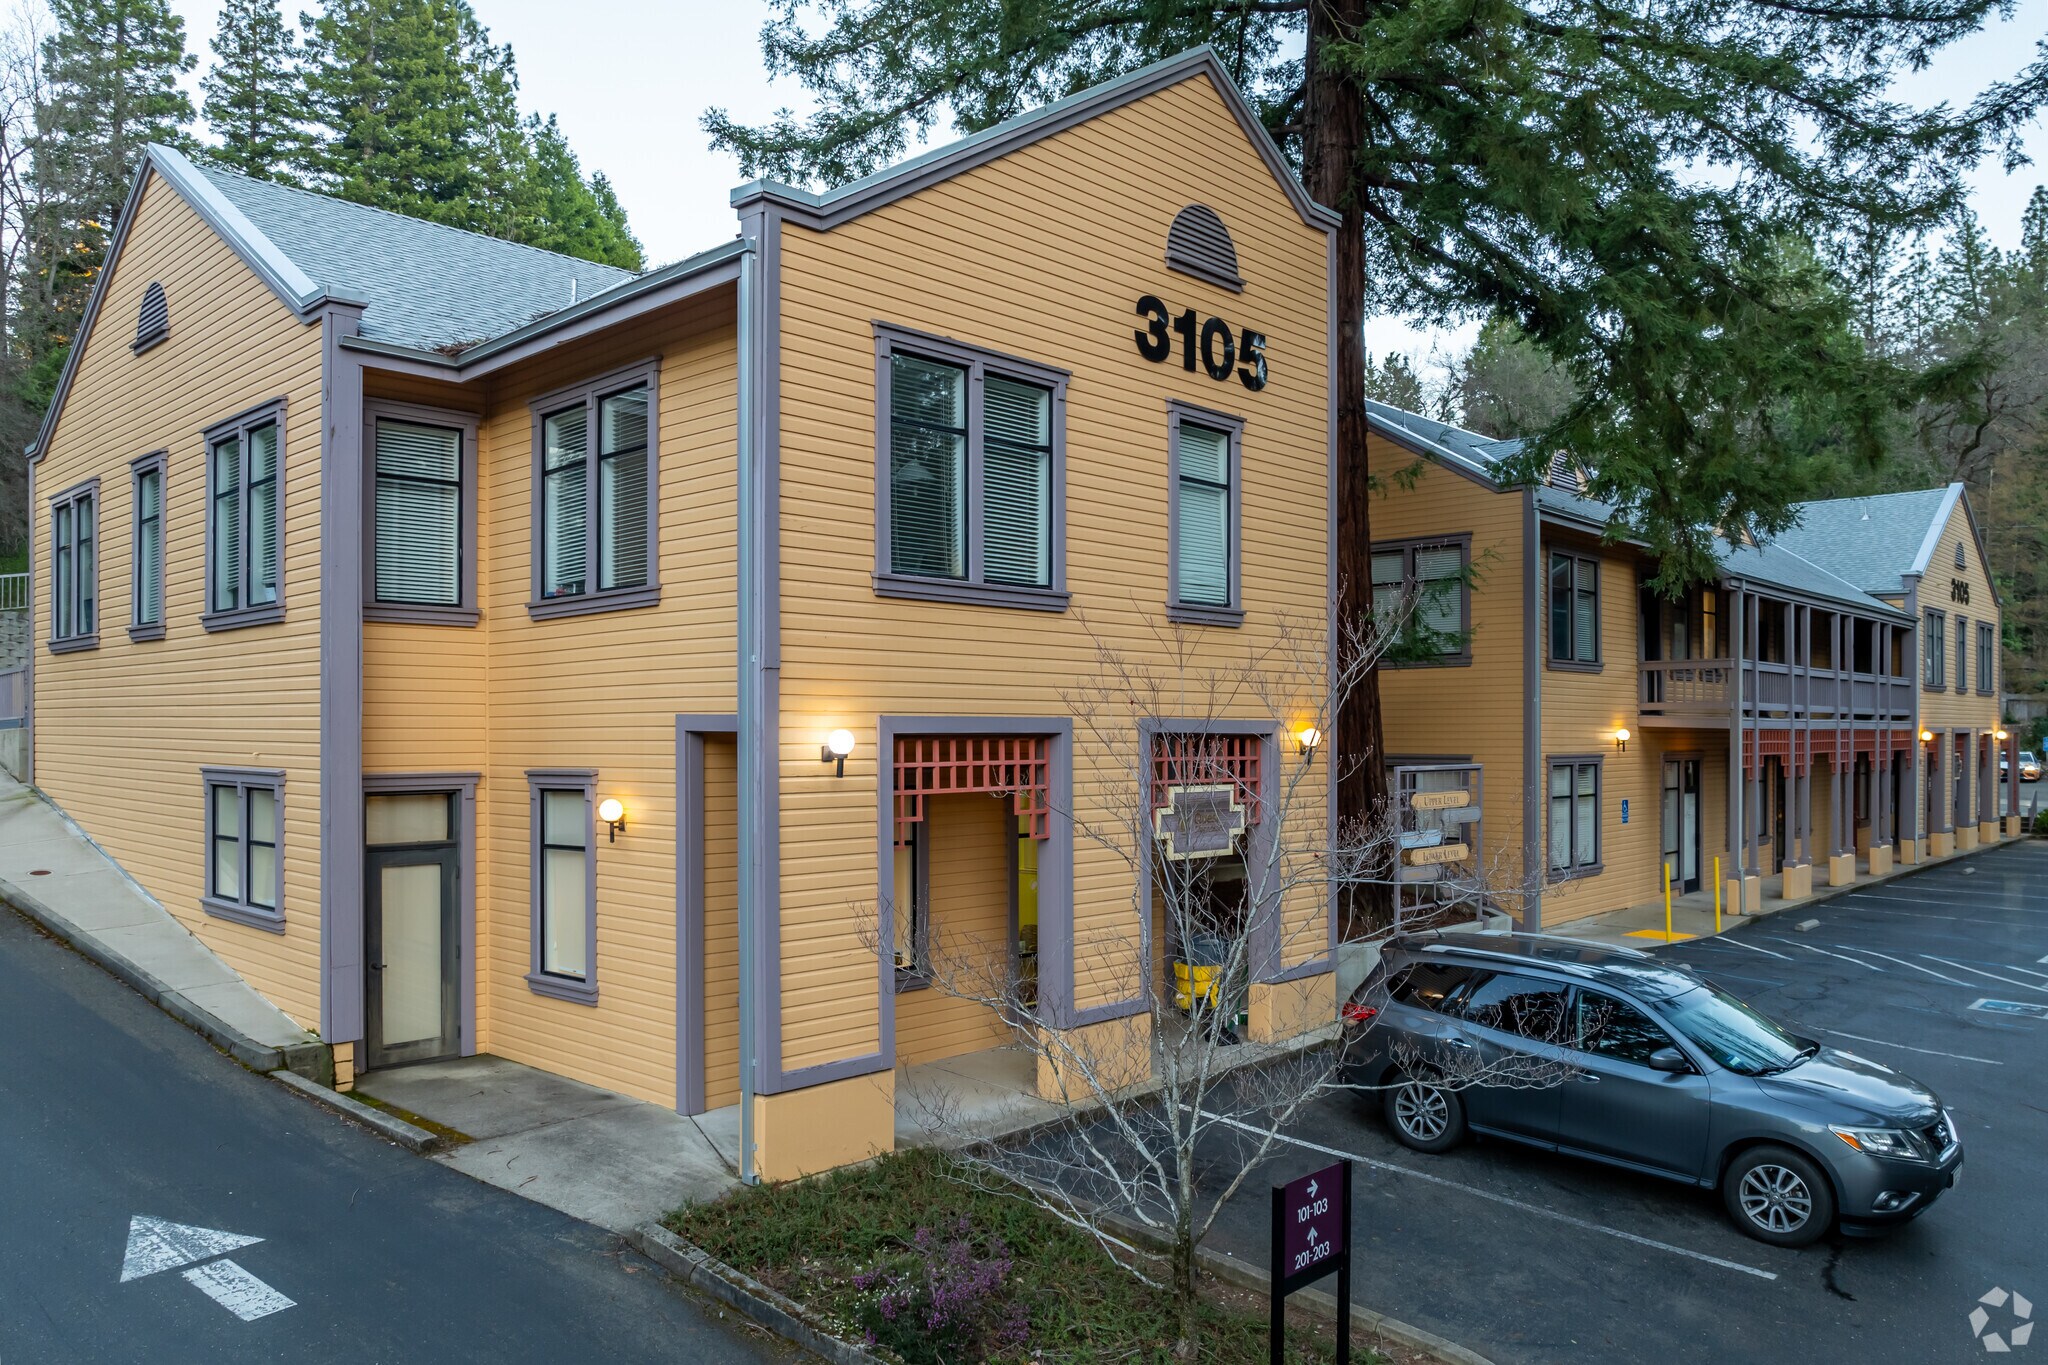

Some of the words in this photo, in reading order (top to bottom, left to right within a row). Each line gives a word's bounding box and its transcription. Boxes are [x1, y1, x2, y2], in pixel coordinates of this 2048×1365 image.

[1134, 295, 1268, 392] 3105
[1298, 1198, 1328, 1223] 101-103
[1295, 1241, 1330, 1270] 201-203
